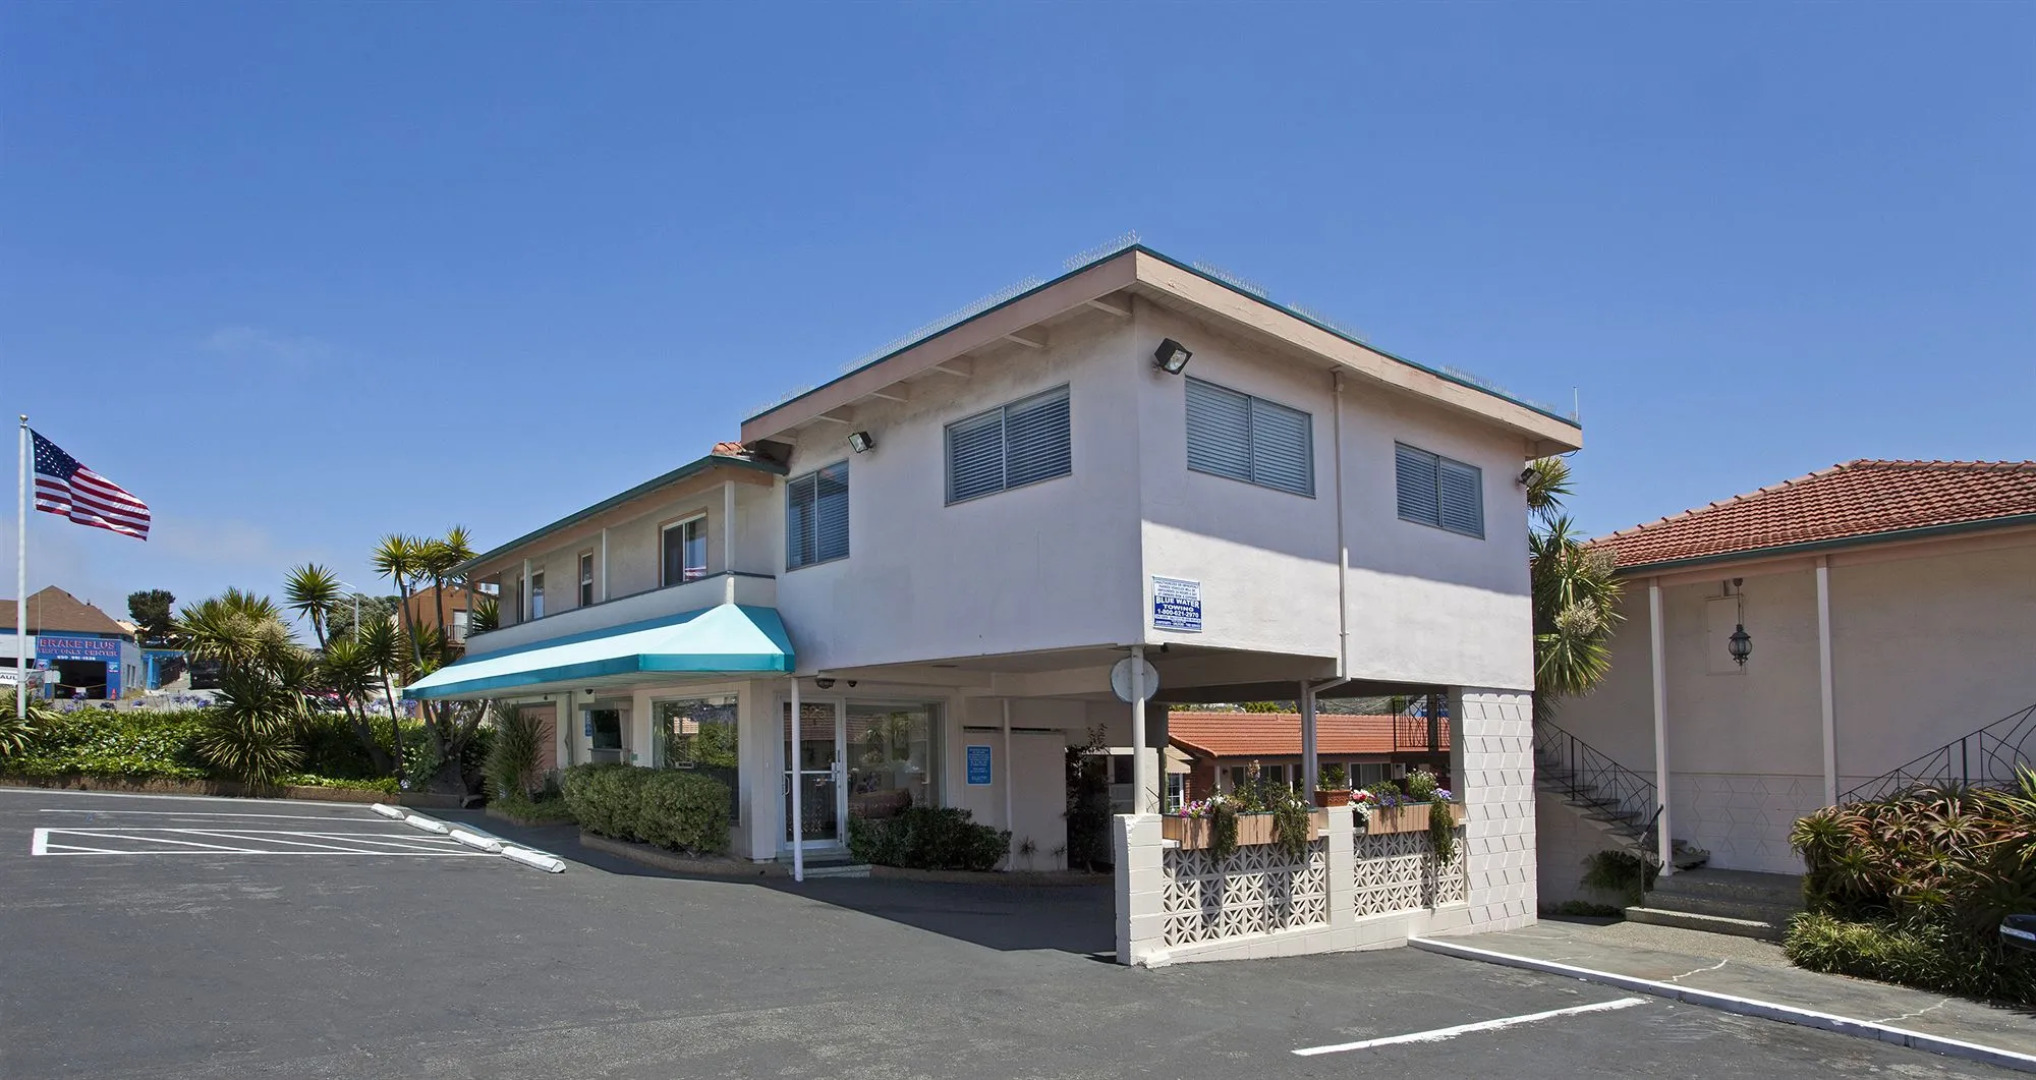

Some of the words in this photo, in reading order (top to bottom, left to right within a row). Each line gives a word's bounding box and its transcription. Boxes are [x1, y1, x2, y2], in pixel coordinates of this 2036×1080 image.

[1163, 604, 1195, 612] TOWING
[1176, 599, 1200, 609] WATER
[40, 639, 82, 648] BRAKE
[85, 641, 115, 650] PLUS
